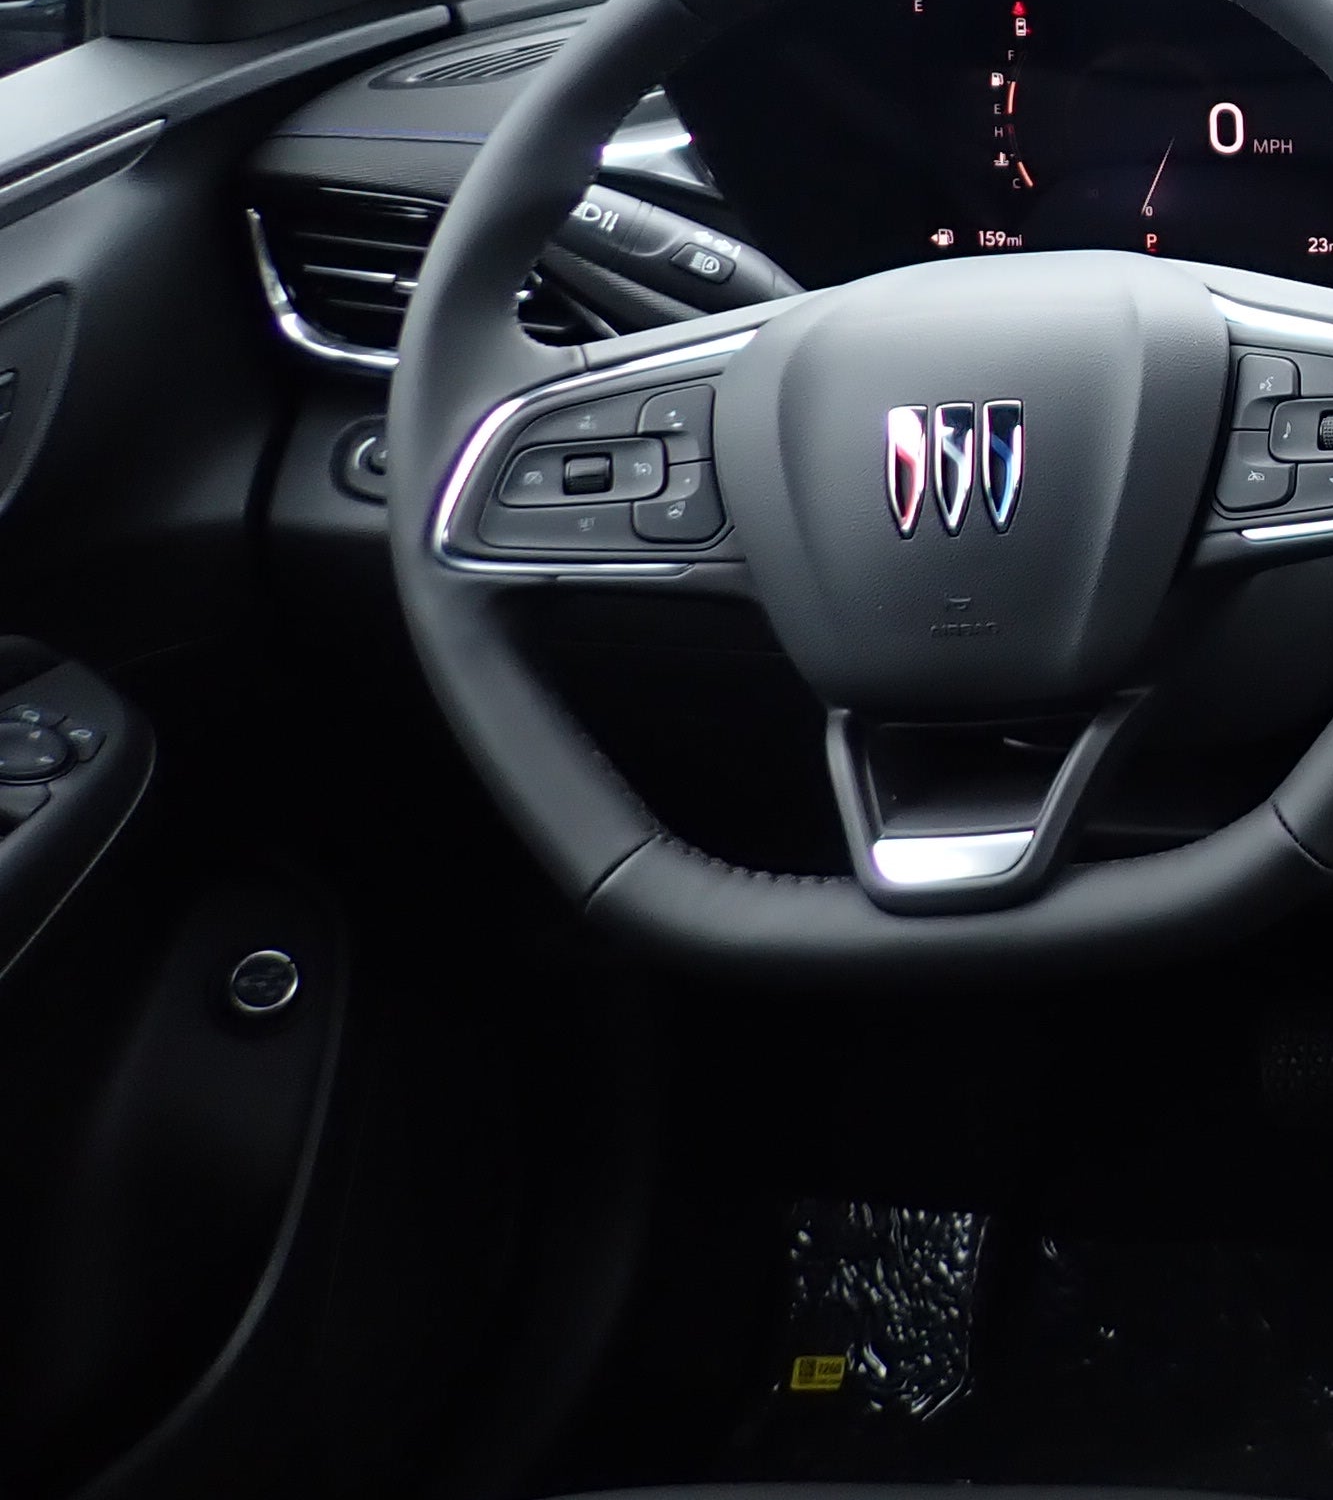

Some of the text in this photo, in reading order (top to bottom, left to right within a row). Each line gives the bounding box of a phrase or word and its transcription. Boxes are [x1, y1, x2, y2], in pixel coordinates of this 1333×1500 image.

[914, 0, 923, 11] E
[994, 127, 1003, 138] H
[1209, 102, 1293, 155] 0 MPH
[1012, 178, 1021, 188] C
[1146, 233, 1157, 249] P
